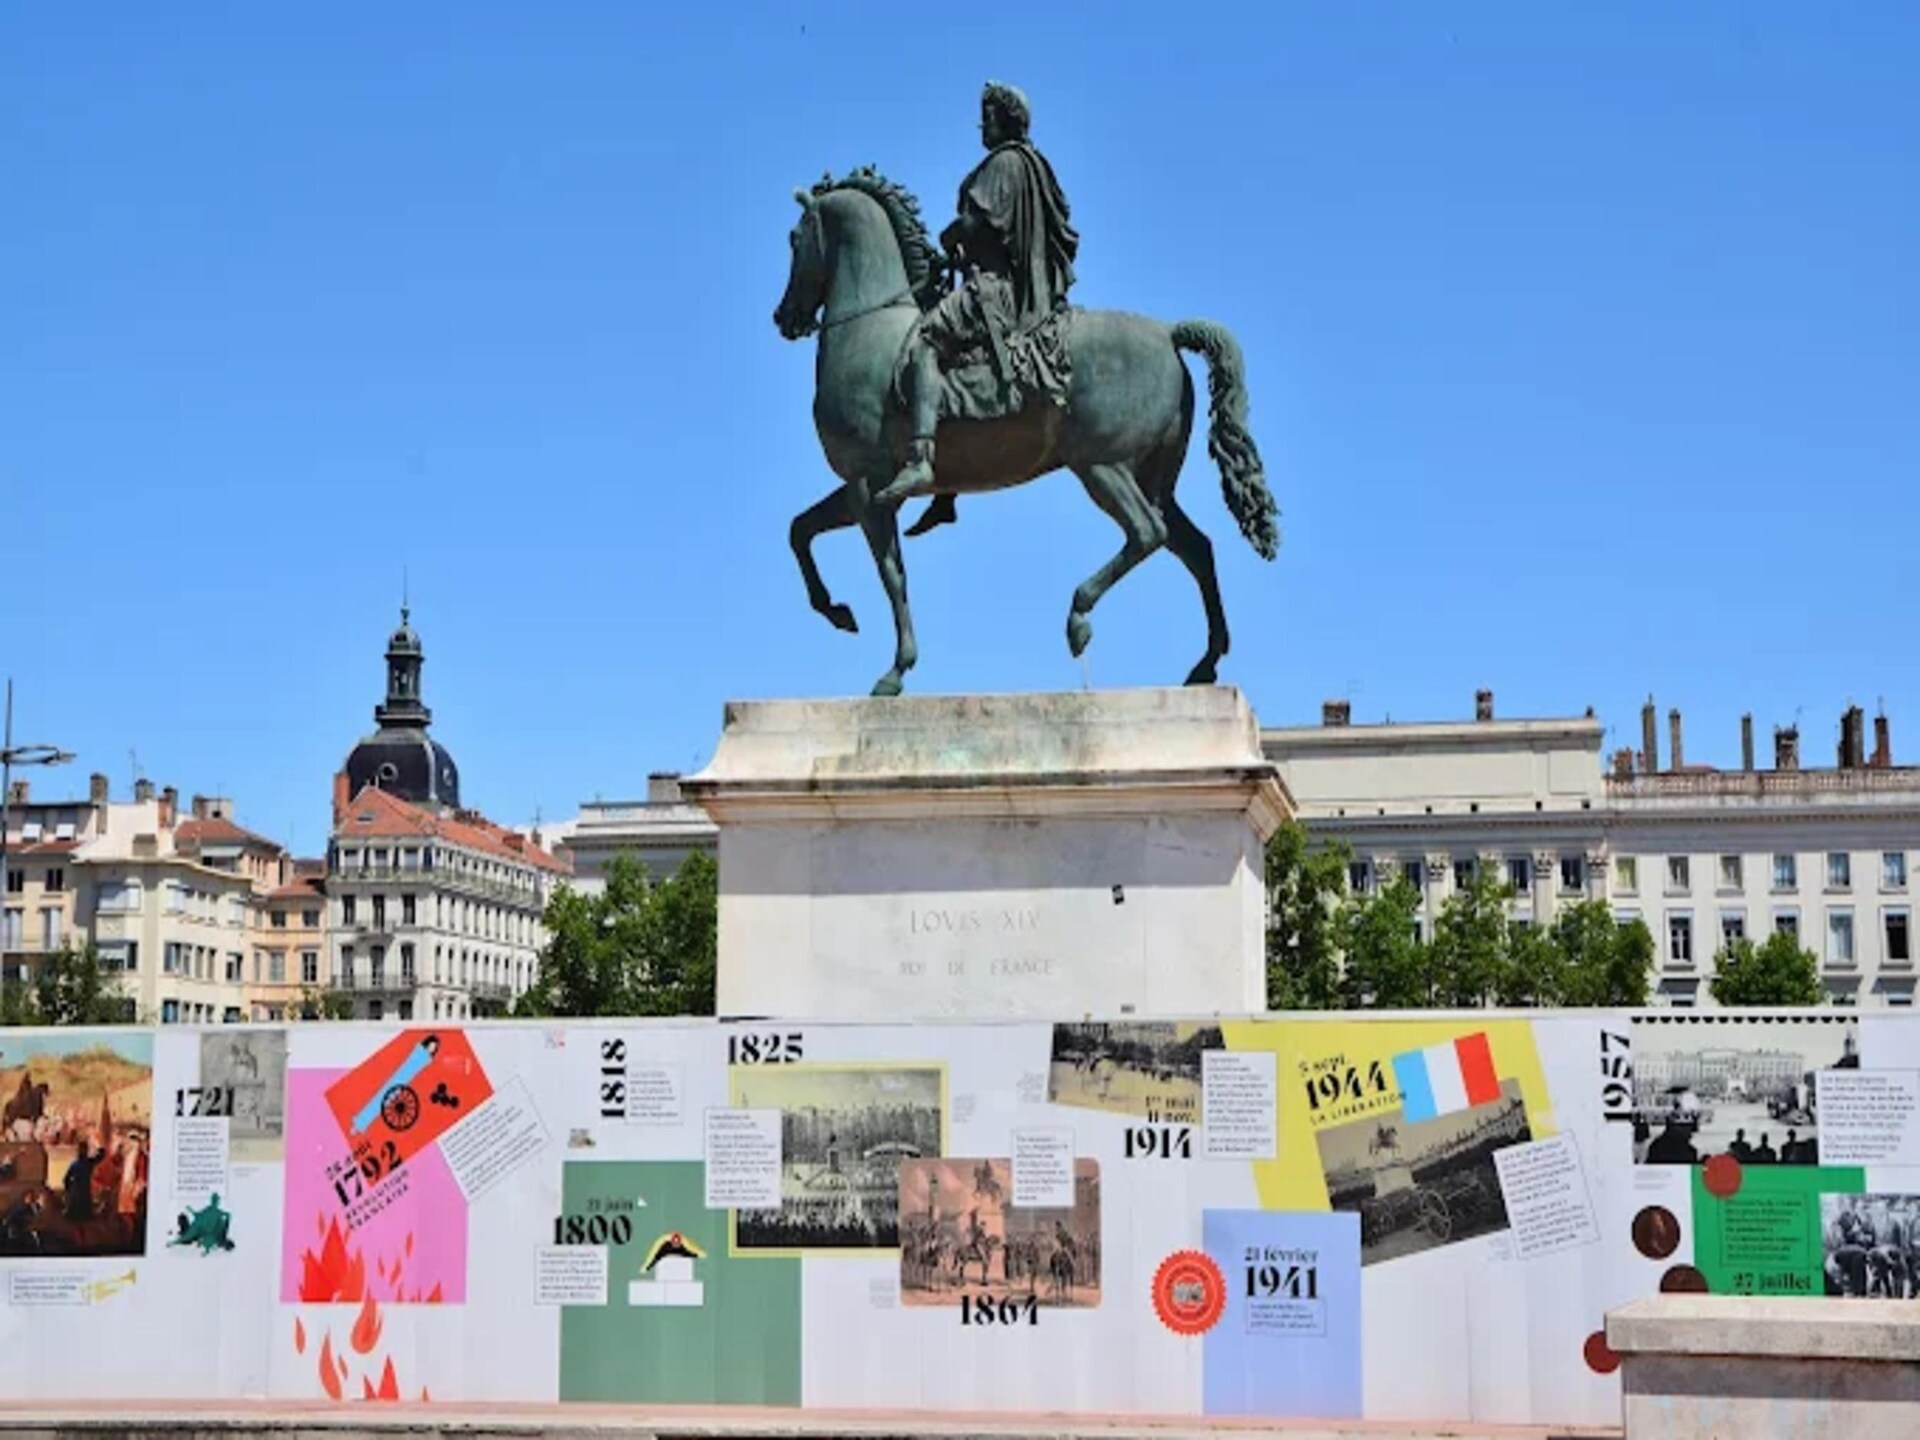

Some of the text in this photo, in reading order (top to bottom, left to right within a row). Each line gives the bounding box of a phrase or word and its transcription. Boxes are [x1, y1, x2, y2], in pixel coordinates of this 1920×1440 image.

[728, 1033, 803, 1065] 1825
[600, 1038, 627, 1119] 1818
[1305, 1059, 1387, 1111] 1944
[1600, 1029, 1633, 1124] 1957
[175, 1086, 236, 1117] 1721
[1123, 1127, 1192, 1159] 1914
[334, 1139, 404, 1208] 1792
[553, 1214, 633, 1246] 1800
[1244, 1265, 1318, 1299] 1941
[962, 1293, 1039, 1326] 1864
